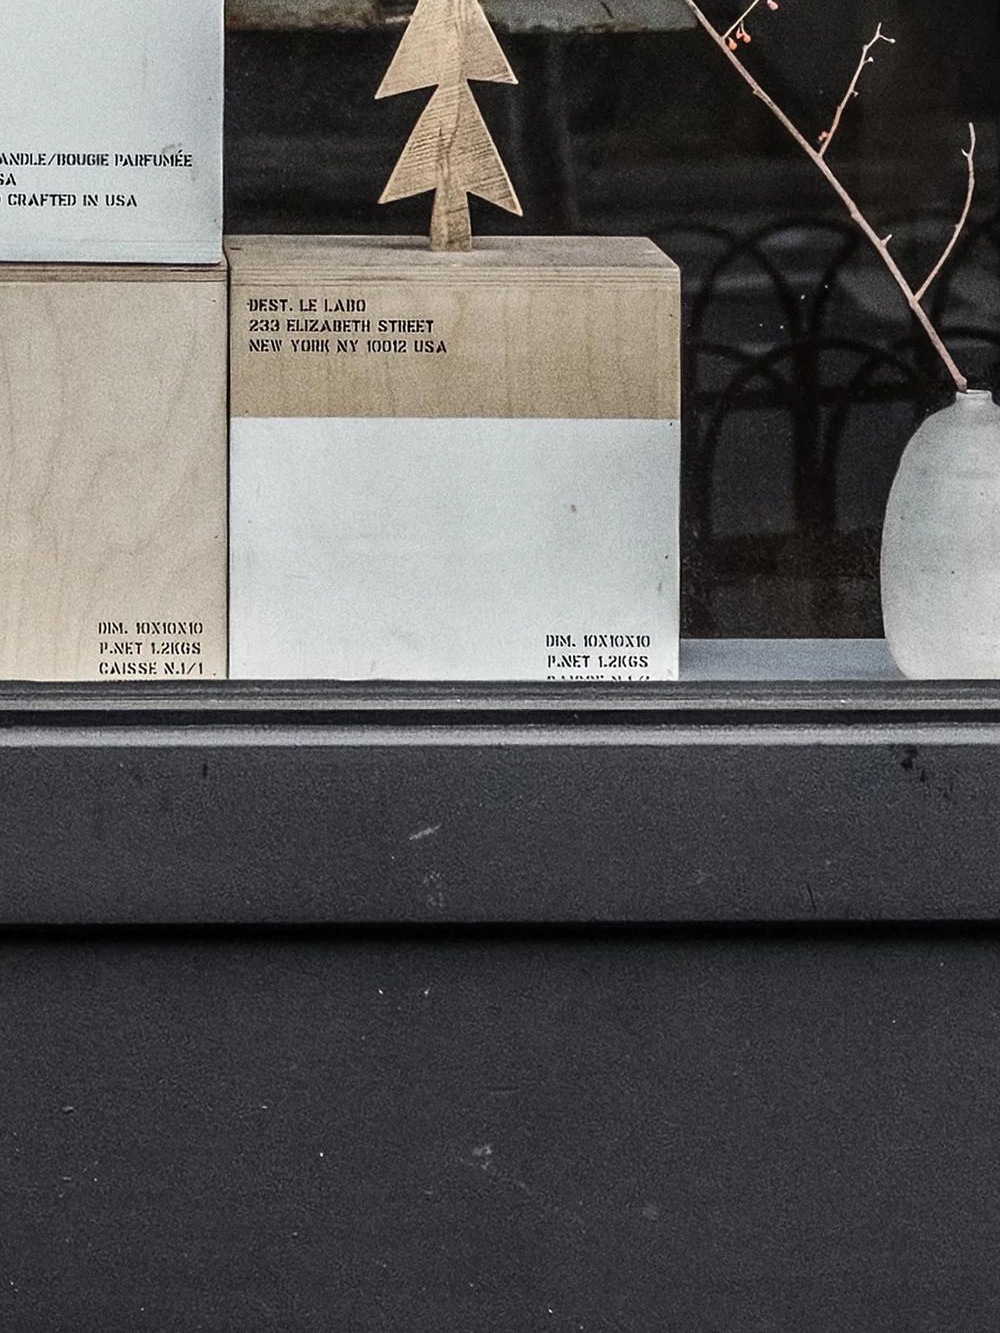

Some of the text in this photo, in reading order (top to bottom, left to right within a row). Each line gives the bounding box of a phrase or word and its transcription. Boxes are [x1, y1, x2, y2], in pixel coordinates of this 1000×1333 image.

[115, 148, 192, 167] PARFUMÉE
[7, 193, 77, 207] CRAFTED
[82, 193, 98, 207] IN
[105, 193, 138, 208] USA
[248, 298, 366, 312] DEST. LE LABO
[249, 319, 434, 333] 233 ELIZABETH STREET
[249, 339, 447, 353] NEW YORK NY 10012 USA
[98, 622, 203, 635] DIM. 10X10X10
[546, 634, 650, 647] DIM. 10X10X10
[100, 642, 201, 655] P.NET 1.2KGS
[547, 655, 648, 668] P.NET 1.2KGS
[99, 662, 157, 675] CAISSE
